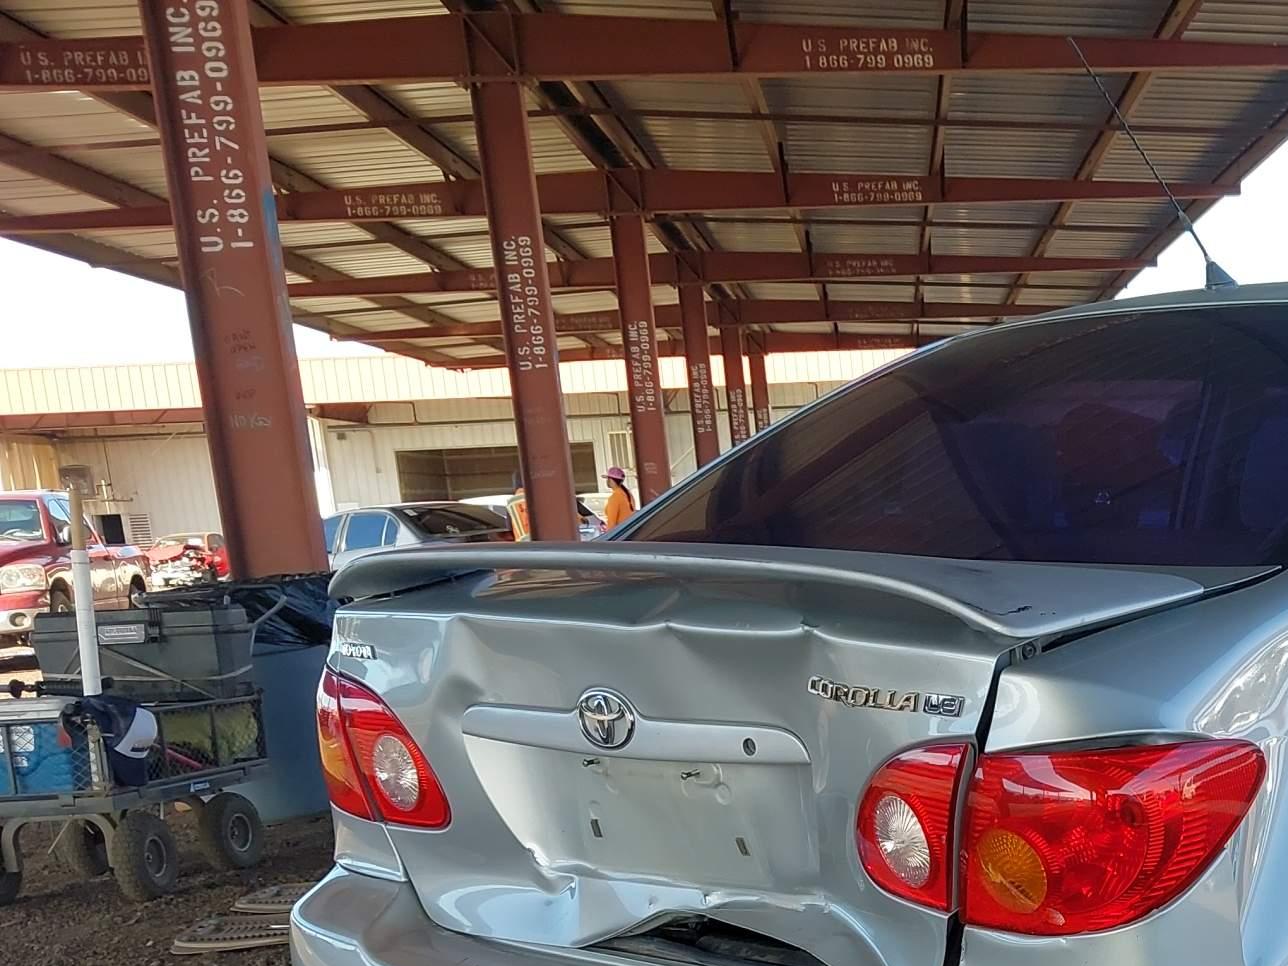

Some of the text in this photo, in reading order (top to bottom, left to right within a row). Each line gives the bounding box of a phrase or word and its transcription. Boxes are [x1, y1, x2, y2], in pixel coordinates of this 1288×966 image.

[63, 50, 129, 66] PREFAB
[839, 38, 898, 52] PREFAB
[905, 37, 933, 53] INC.
[25, 67, 148, 84] 1-866-799-09
[176, 70, 214, 181] PREFAB
[194, 0, 254, 249] 1-866-799-0969
[371, 192, 415, 205] PREFAB
[857, 181, 898, 192] PREFAB
[197, 200, 224, 252] U.S.
[503, 235, 533, 371] U.S. PREFAB INC.
[518, 236, 548, 369] 1-866-799-0969
[630, 346, 643, 387] PREFAB
[807, 675, 920, 713] COROLLA
